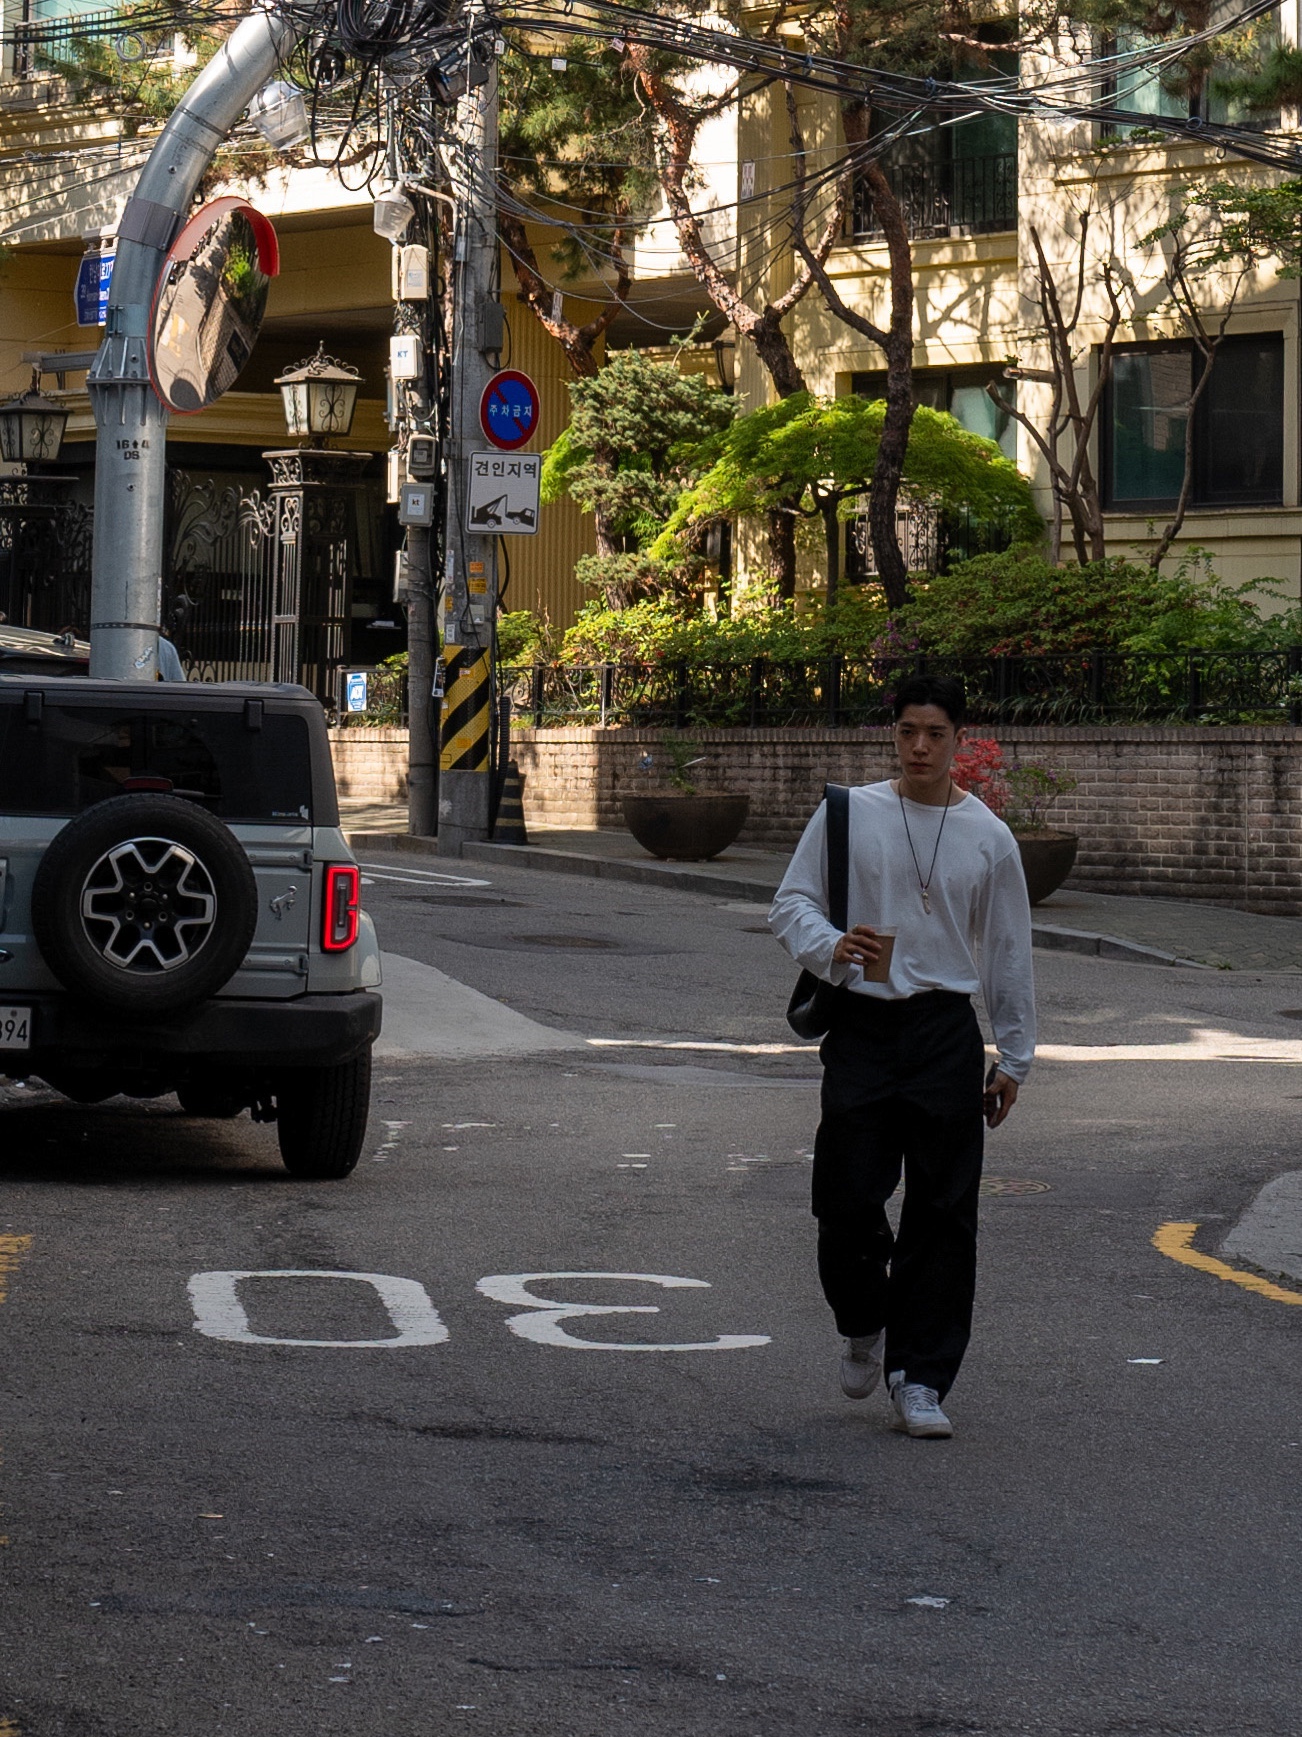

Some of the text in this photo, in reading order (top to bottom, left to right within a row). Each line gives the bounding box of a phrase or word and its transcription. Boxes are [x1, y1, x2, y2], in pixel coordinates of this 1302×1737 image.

[397, 350, 408, 358] KT
[489, 404, 532, 418] 주차금지
[116, 439, 130, 450] 16
[123, 450, 140, 460] DS
[475, 460, 537, 478] 견인지역
[0, 1019, 28, 1042] 94
[186, 1270, 772, 1351] 30
